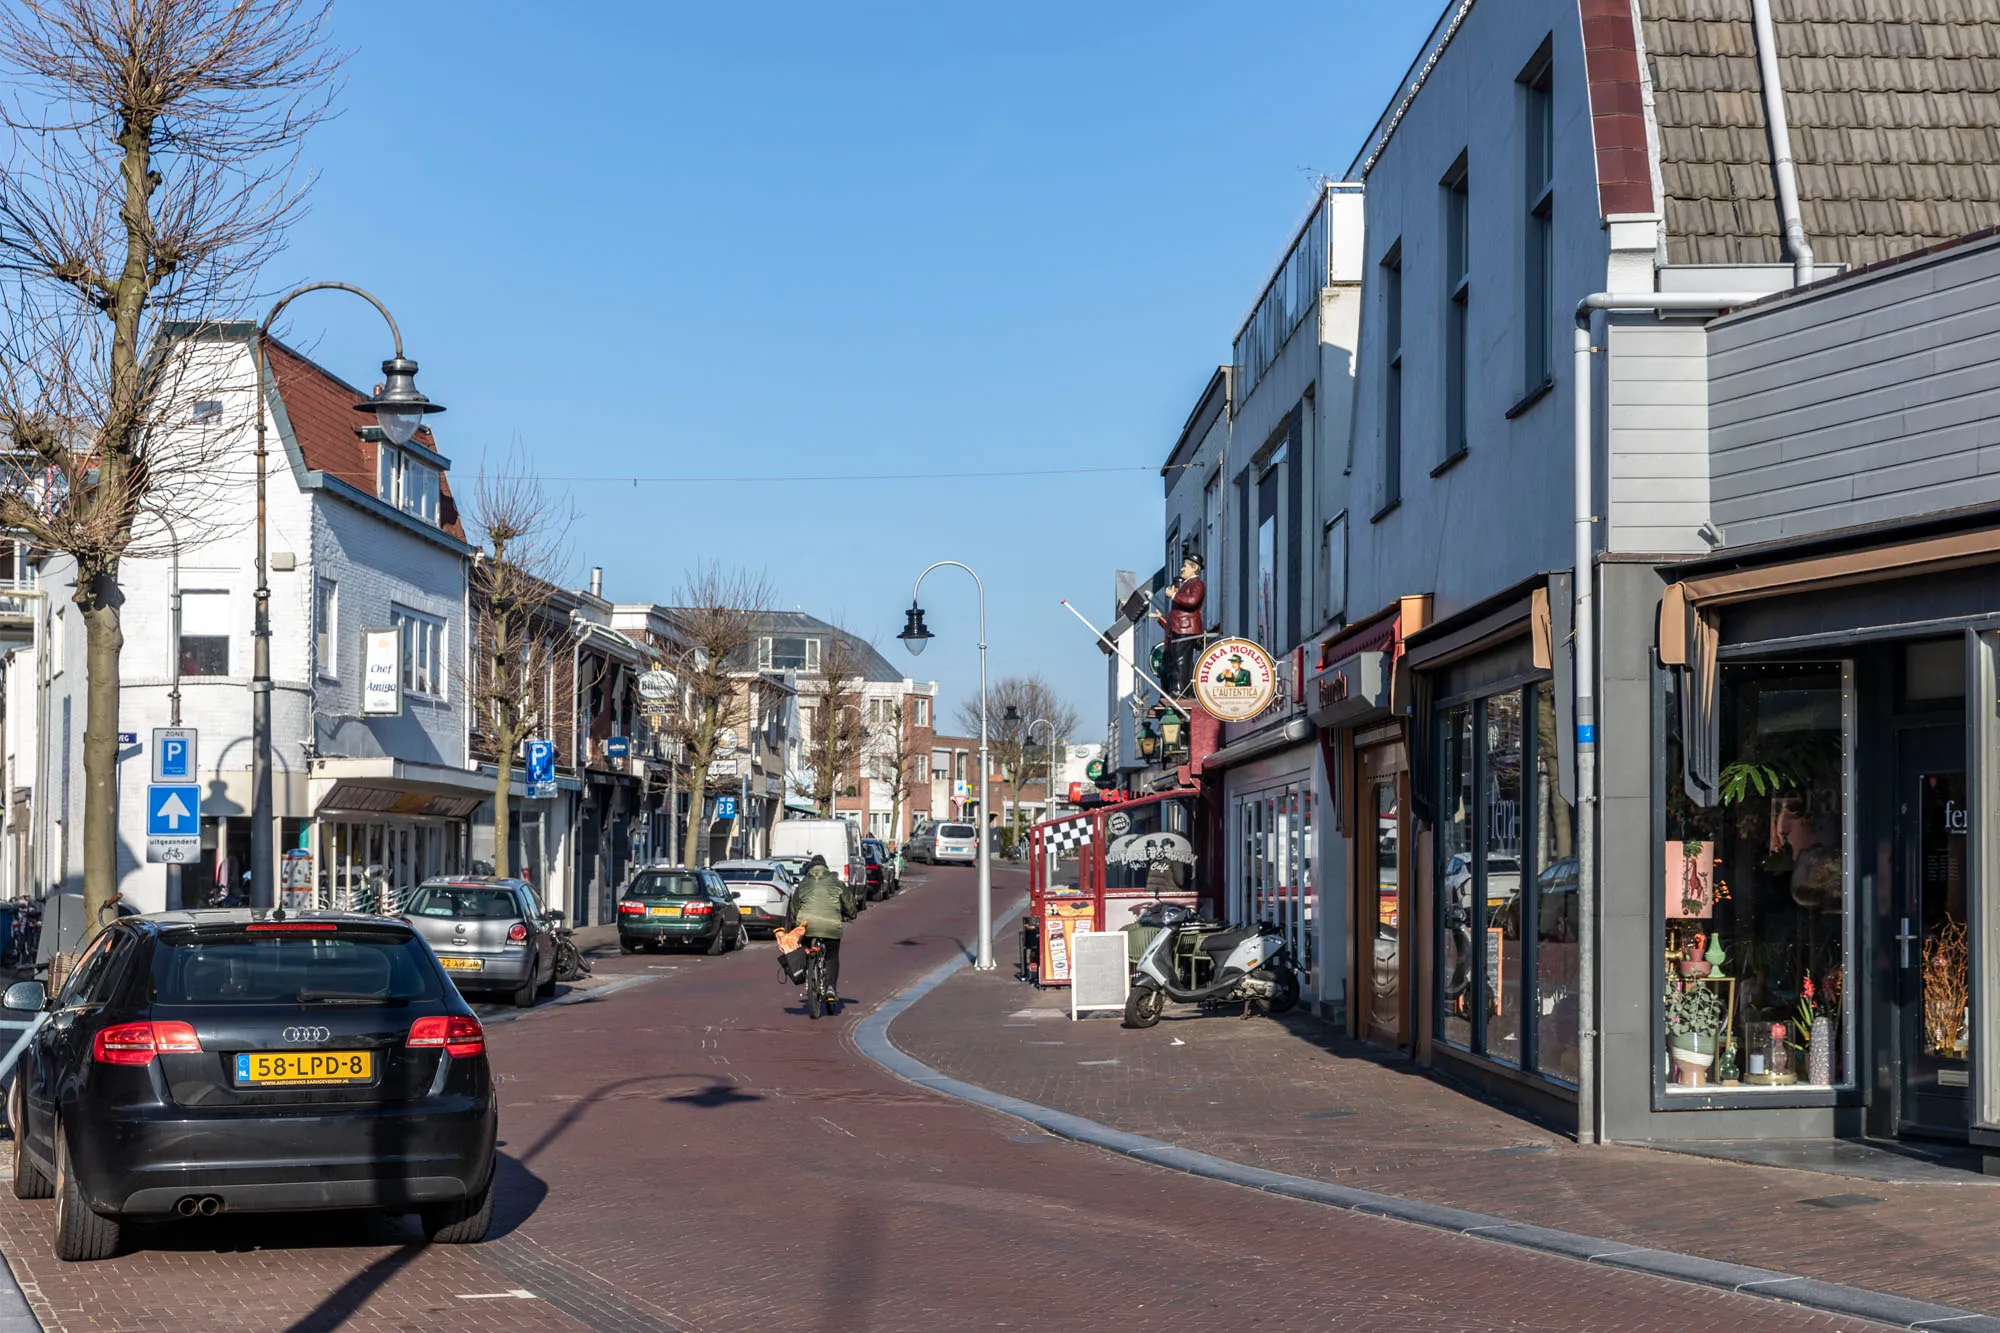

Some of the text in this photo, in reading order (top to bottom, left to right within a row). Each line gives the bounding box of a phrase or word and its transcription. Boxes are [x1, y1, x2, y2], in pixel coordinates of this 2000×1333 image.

[370, 664, 393, 675] Chef
[1201, 645, 1270, 683] BIRRA MORETTI
[366, 682, 397, 692] Amigo
[1213, 688, 1258, 697] L'AUTENTICA
[167, 742, 181, 762] P
[532, 744, 548, 765] P
[1491, 777, 1516, 840] fera
[149, 838, 198, 846] uitgezonderd
[258, 1056, 363, 1077] 58-LPD-8
